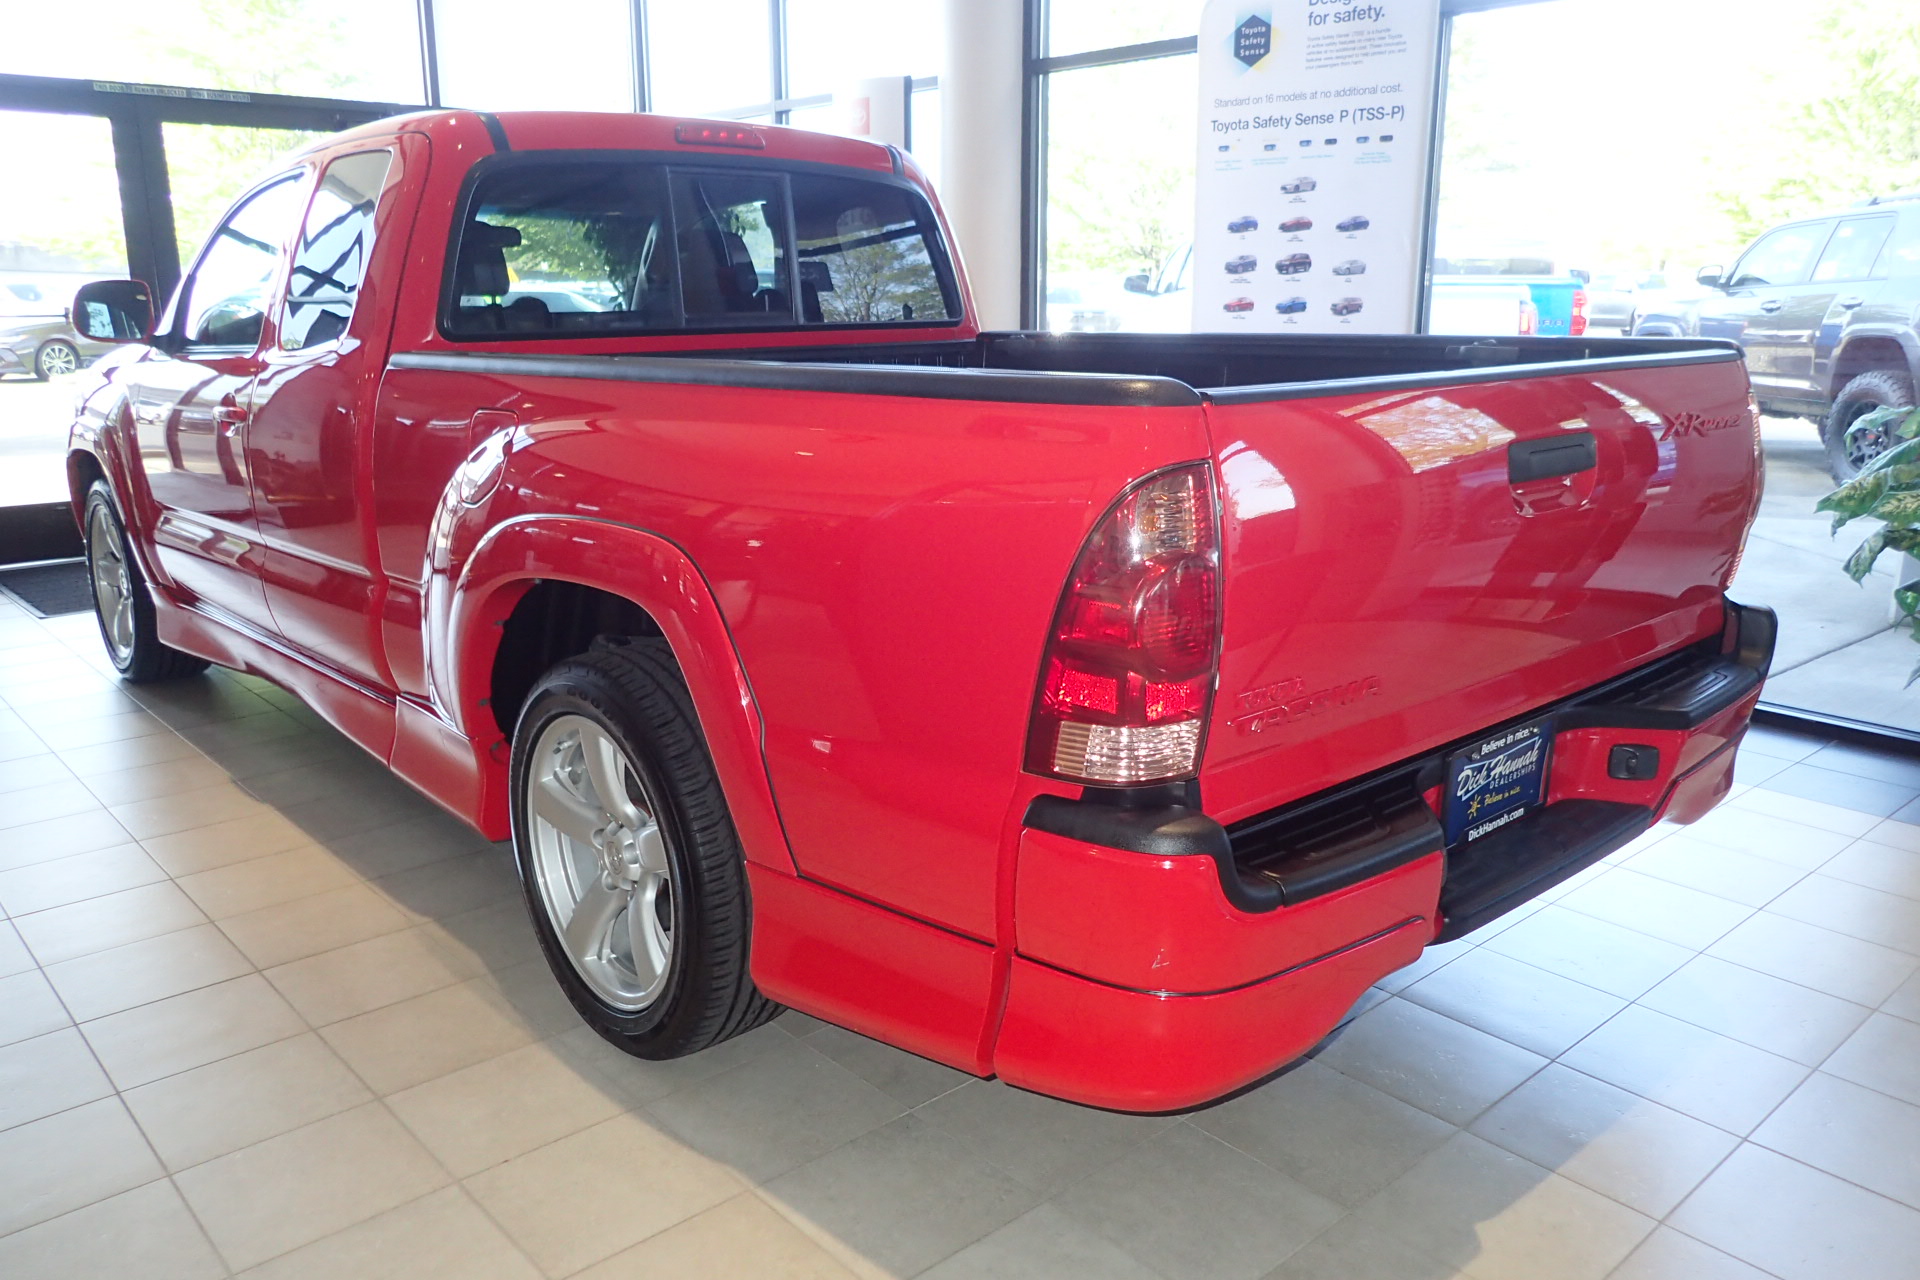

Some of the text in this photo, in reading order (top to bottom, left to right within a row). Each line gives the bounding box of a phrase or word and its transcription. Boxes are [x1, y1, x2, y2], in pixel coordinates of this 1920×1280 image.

[1308, 5, 1385, 26] for safety.
[1240, 37, 1265, 46] Safety
[1241, 26, 1266, 35] Toyota
[1240, 48, 1265, 57] Sense
[1214, 83, 1404, 109] Standard on 16 models at no additional cost.
[1211, 105, 1405, 135] Toyota Safety Sense P (TSS-P)
[1481, 738, 1506, 755] Believe
[1506, 733, 1514, 744] in
[1457, 739, 1542, 797] Dick Hannah
[1489, 763, 1536, 789] DEALERSHIPS
[1468, 807, 1524, 842] DickHannah.com
